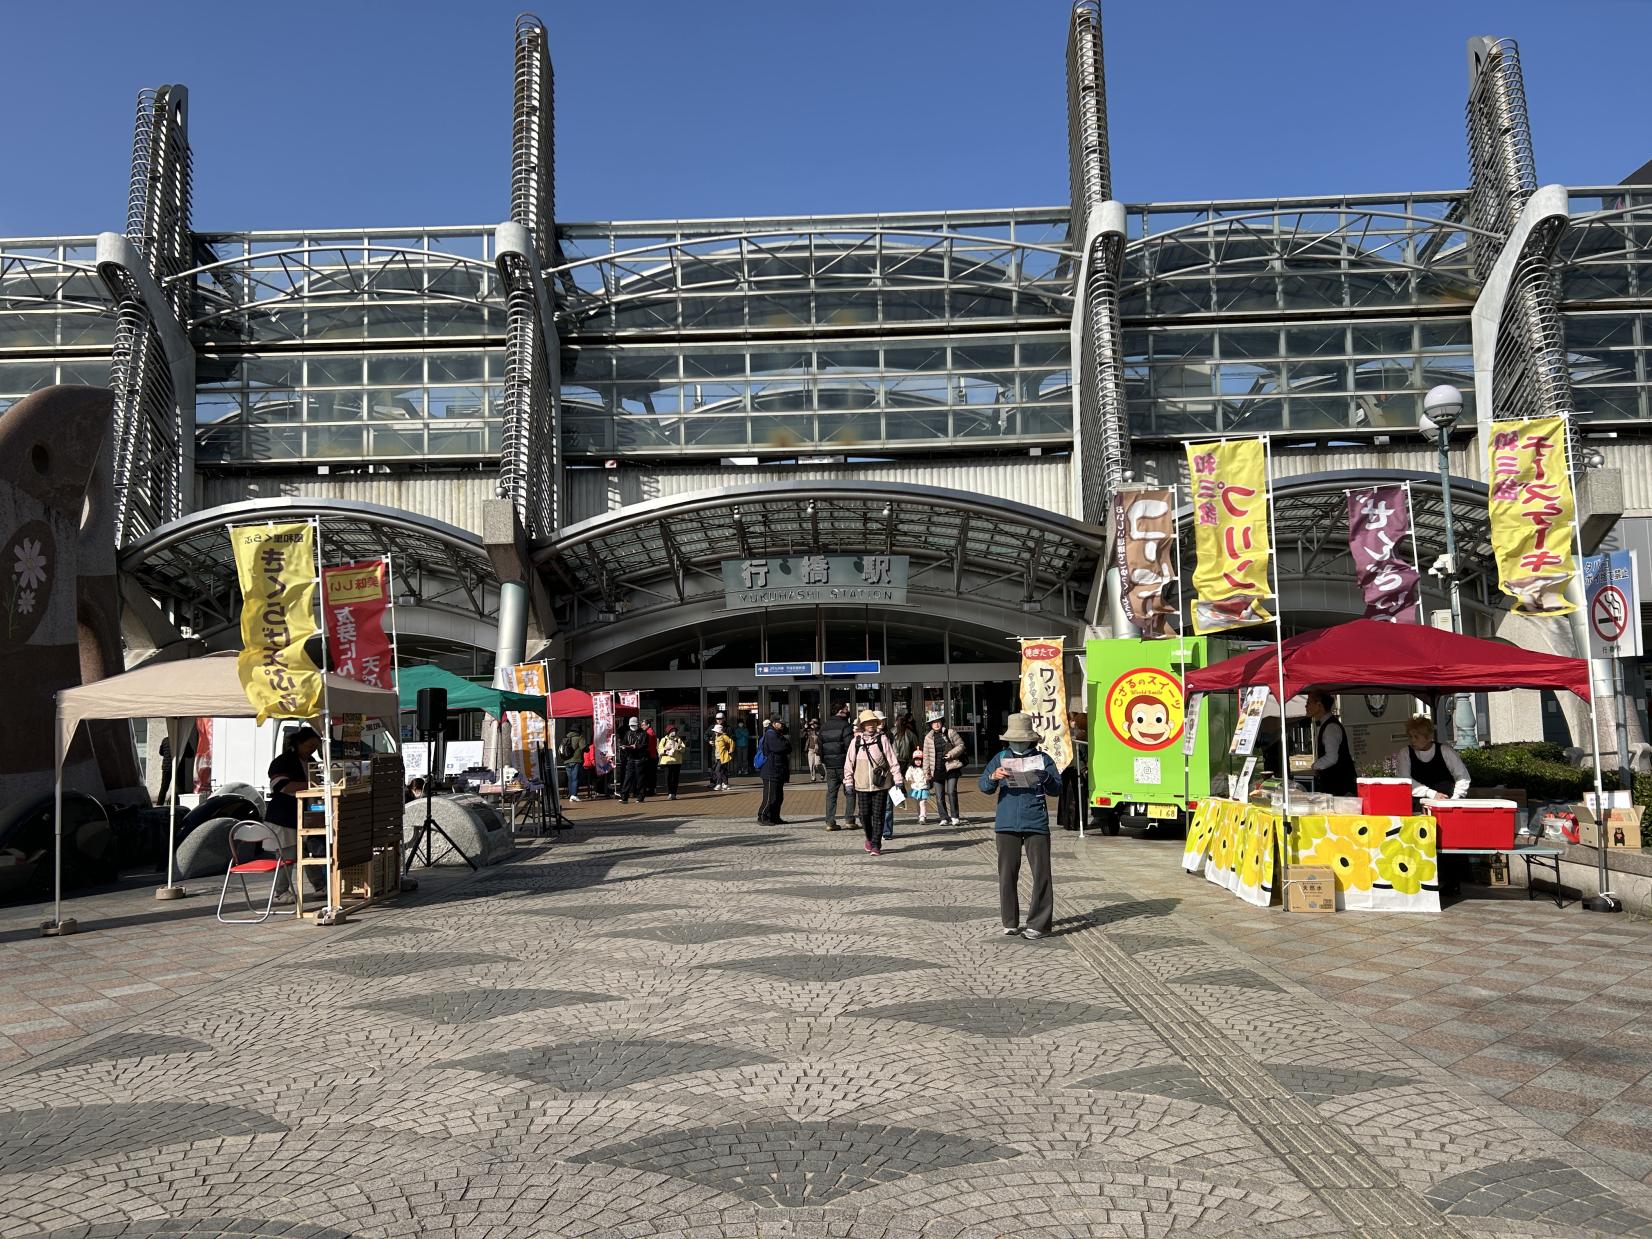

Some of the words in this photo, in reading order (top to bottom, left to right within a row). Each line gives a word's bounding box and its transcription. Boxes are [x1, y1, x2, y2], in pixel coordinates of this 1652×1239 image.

[741, 555, 891, 588] 行橋駅
[740, 590, 821, 603] YUKUHASHI
[830, 588, 893, 600] STATION
[1025, 648, 1056, 657] 焼きたて
[1039, 667, 1061, 731] ワッフル
